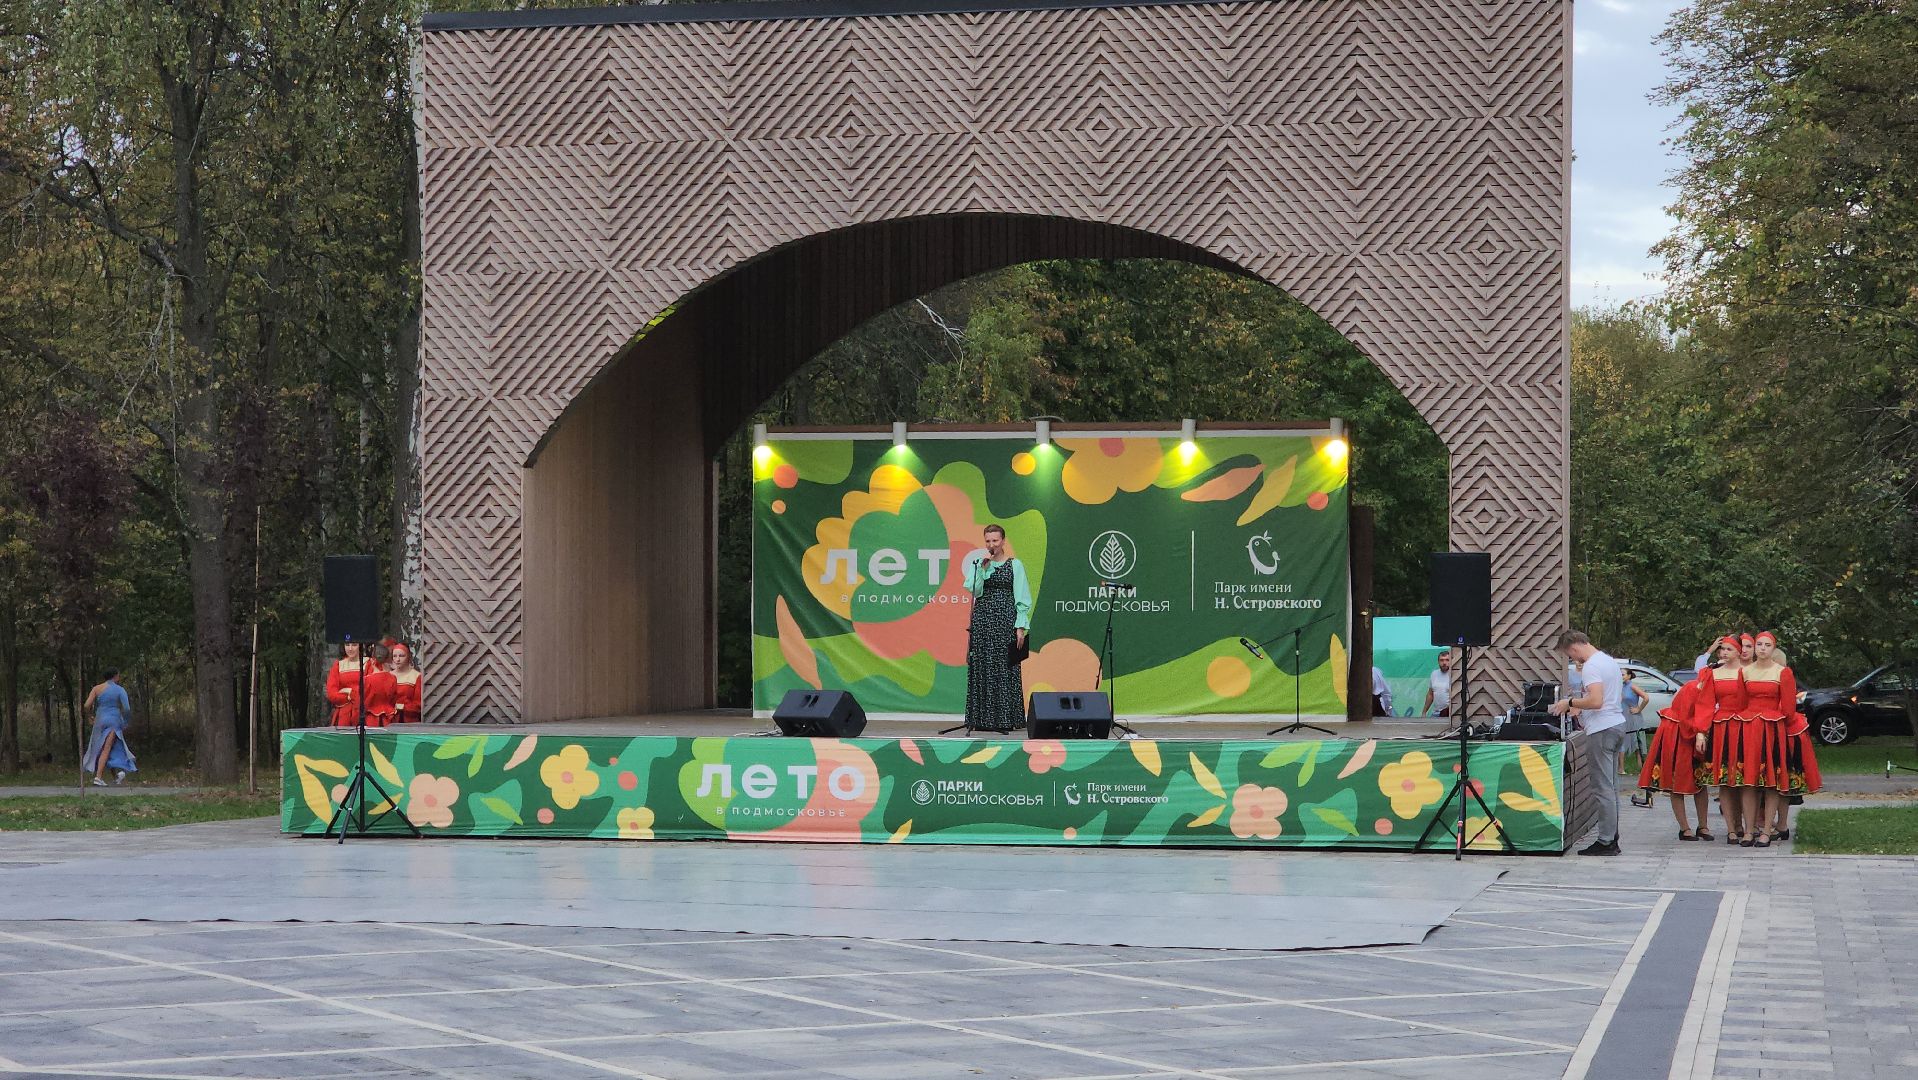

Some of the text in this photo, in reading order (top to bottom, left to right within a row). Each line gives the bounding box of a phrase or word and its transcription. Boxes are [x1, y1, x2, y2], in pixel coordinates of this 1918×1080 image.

[1088, 586, 1137, 598] ПАРКИ
[1214, 582, 1292, 595] Парк имени
[858, 594, 976, 604] ПОДМОСКОВЬ
[1214, 596, 1322, 610] Н. Островского
[1055, 600, 1170, 612] ПОДМОСКОВЬЯ
[937, 781, 983, 792] ПАРКИ
[1087, 783, 1146, 794] Парк имени
[937, 794, 1043, 806] ПОДМОСКОВЬЯ
[1087, 793, 1169, 804] Н. Островского
